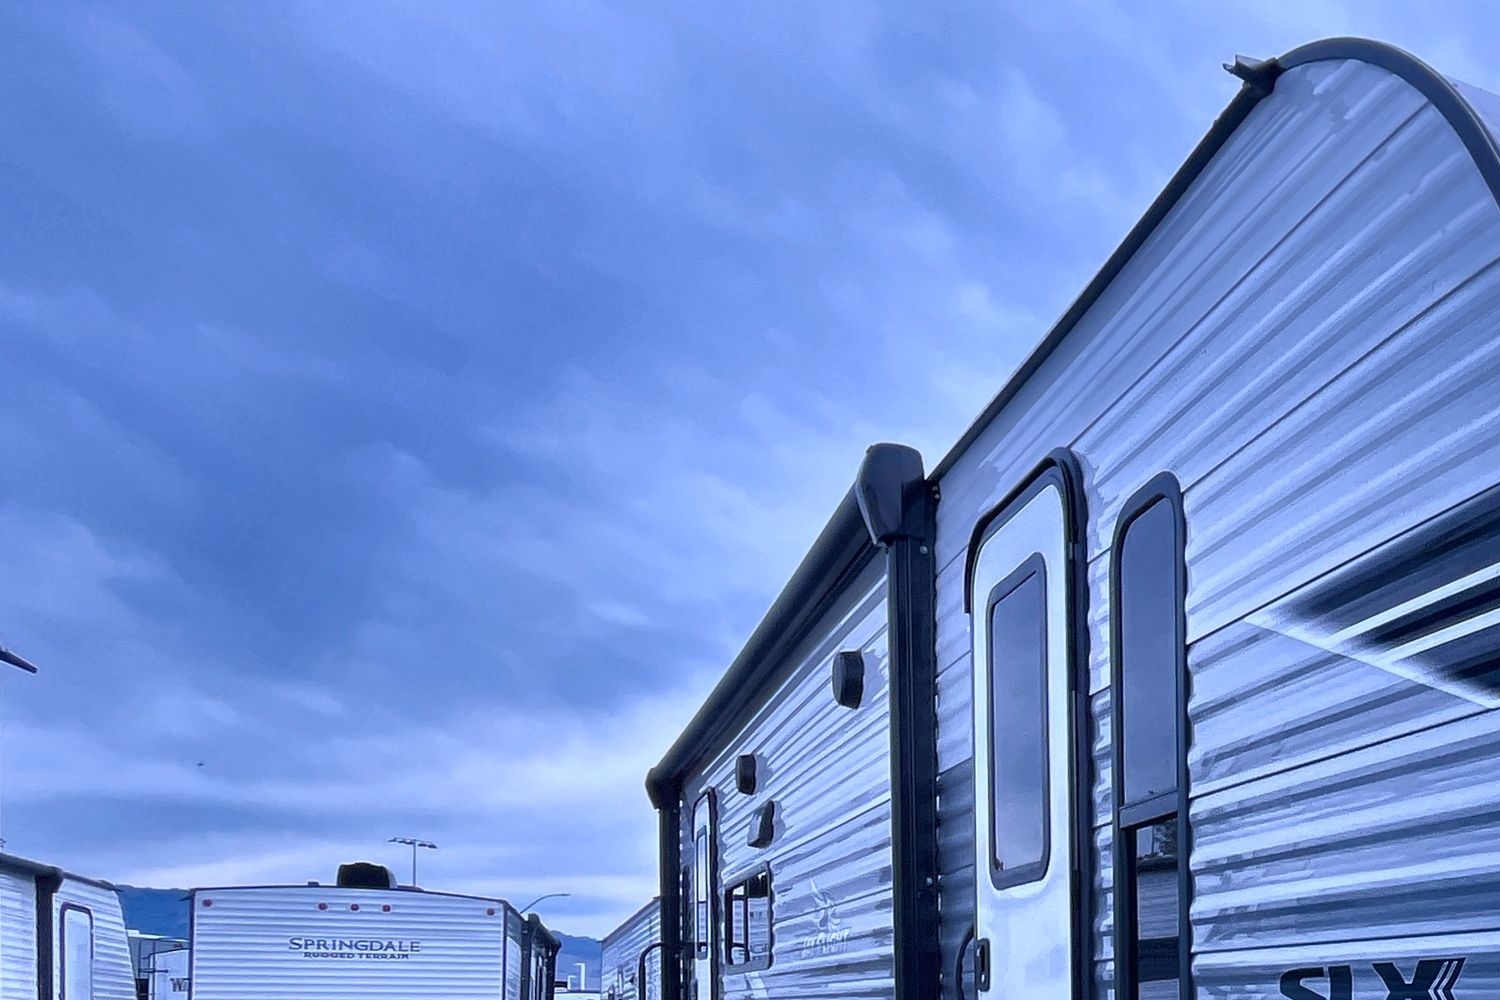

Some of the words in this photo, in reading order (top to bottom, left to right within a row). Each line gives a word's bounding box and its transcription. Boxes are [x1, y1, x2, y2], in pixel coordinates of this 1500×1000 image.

[288, 937, 422, 952] SPRINGDALE
[303, 951, 355, 959] RUGGED
[358, 952, 409, 960] TERRAIN
